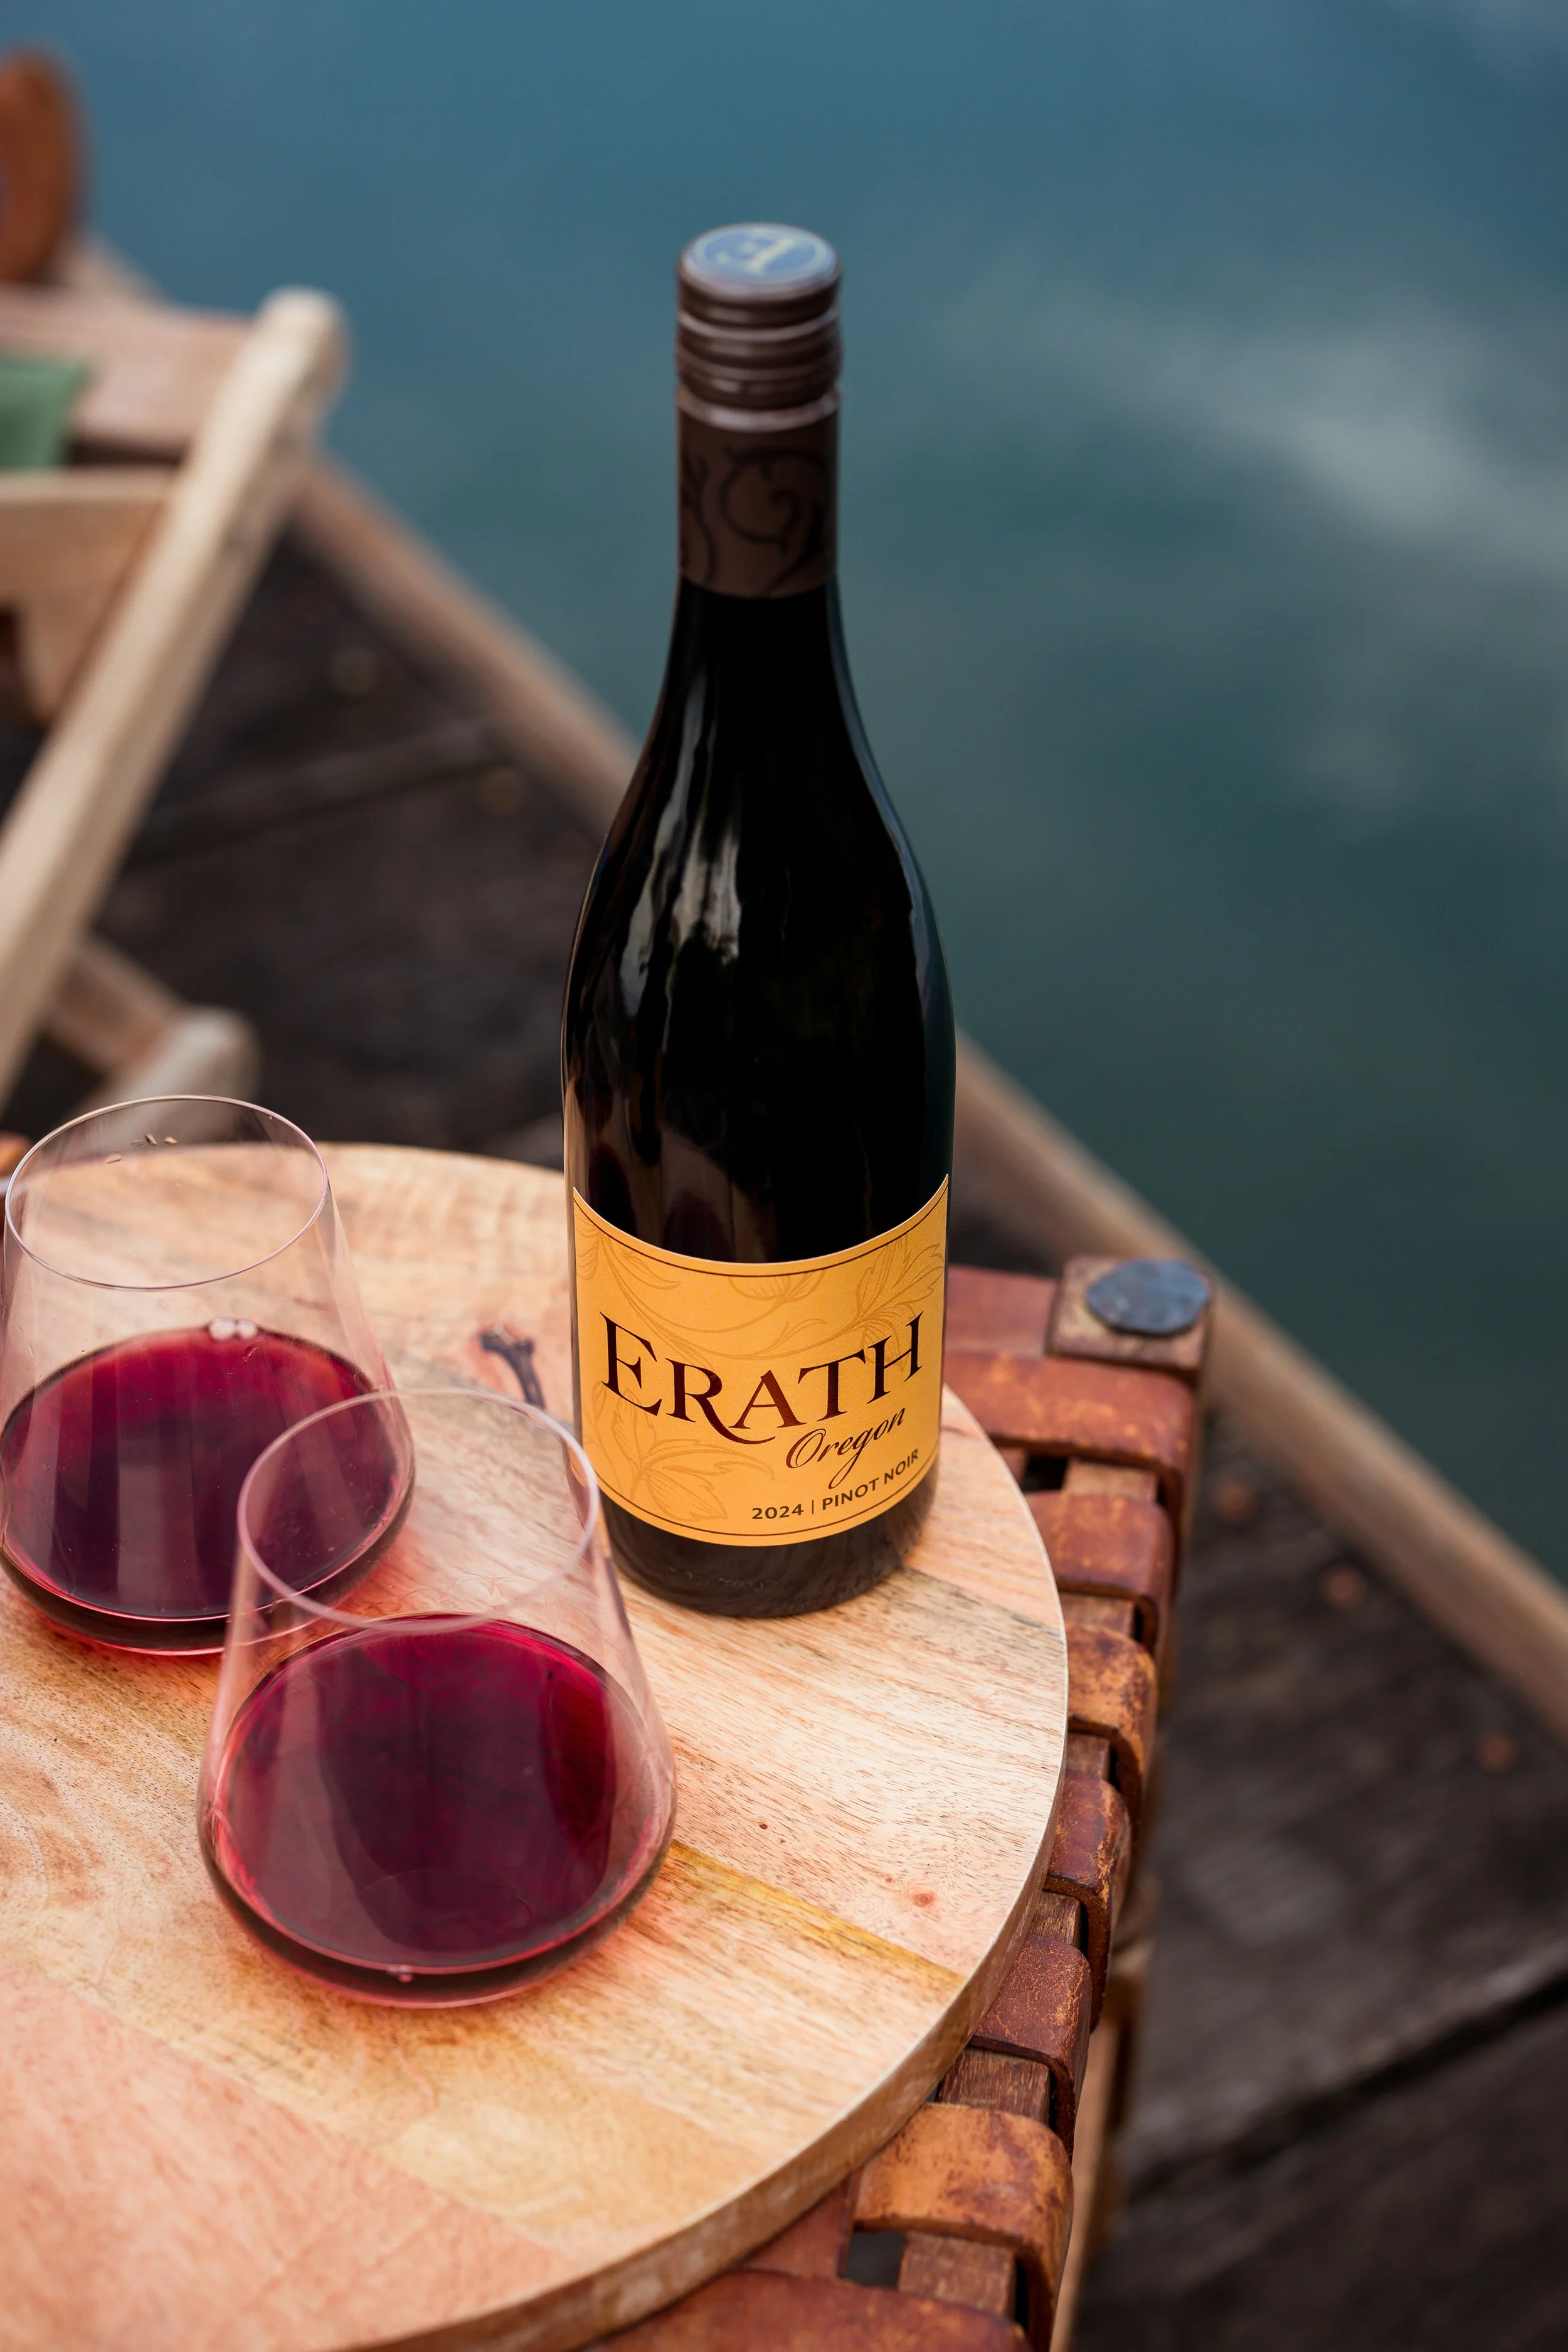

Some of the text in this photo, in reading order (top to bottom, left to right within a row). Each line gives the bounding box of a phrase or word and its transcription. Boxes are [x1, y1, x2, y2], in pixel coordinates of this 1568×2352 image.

[600, 1311, 924, 1444] ERATH
[753, 1506, 803, 1519] 2024
[823, 1478, 879, 1510] PINOT
[884, 1449, 918, 1484] NOIR
[787, 1408, 906, 1489] Oregon
